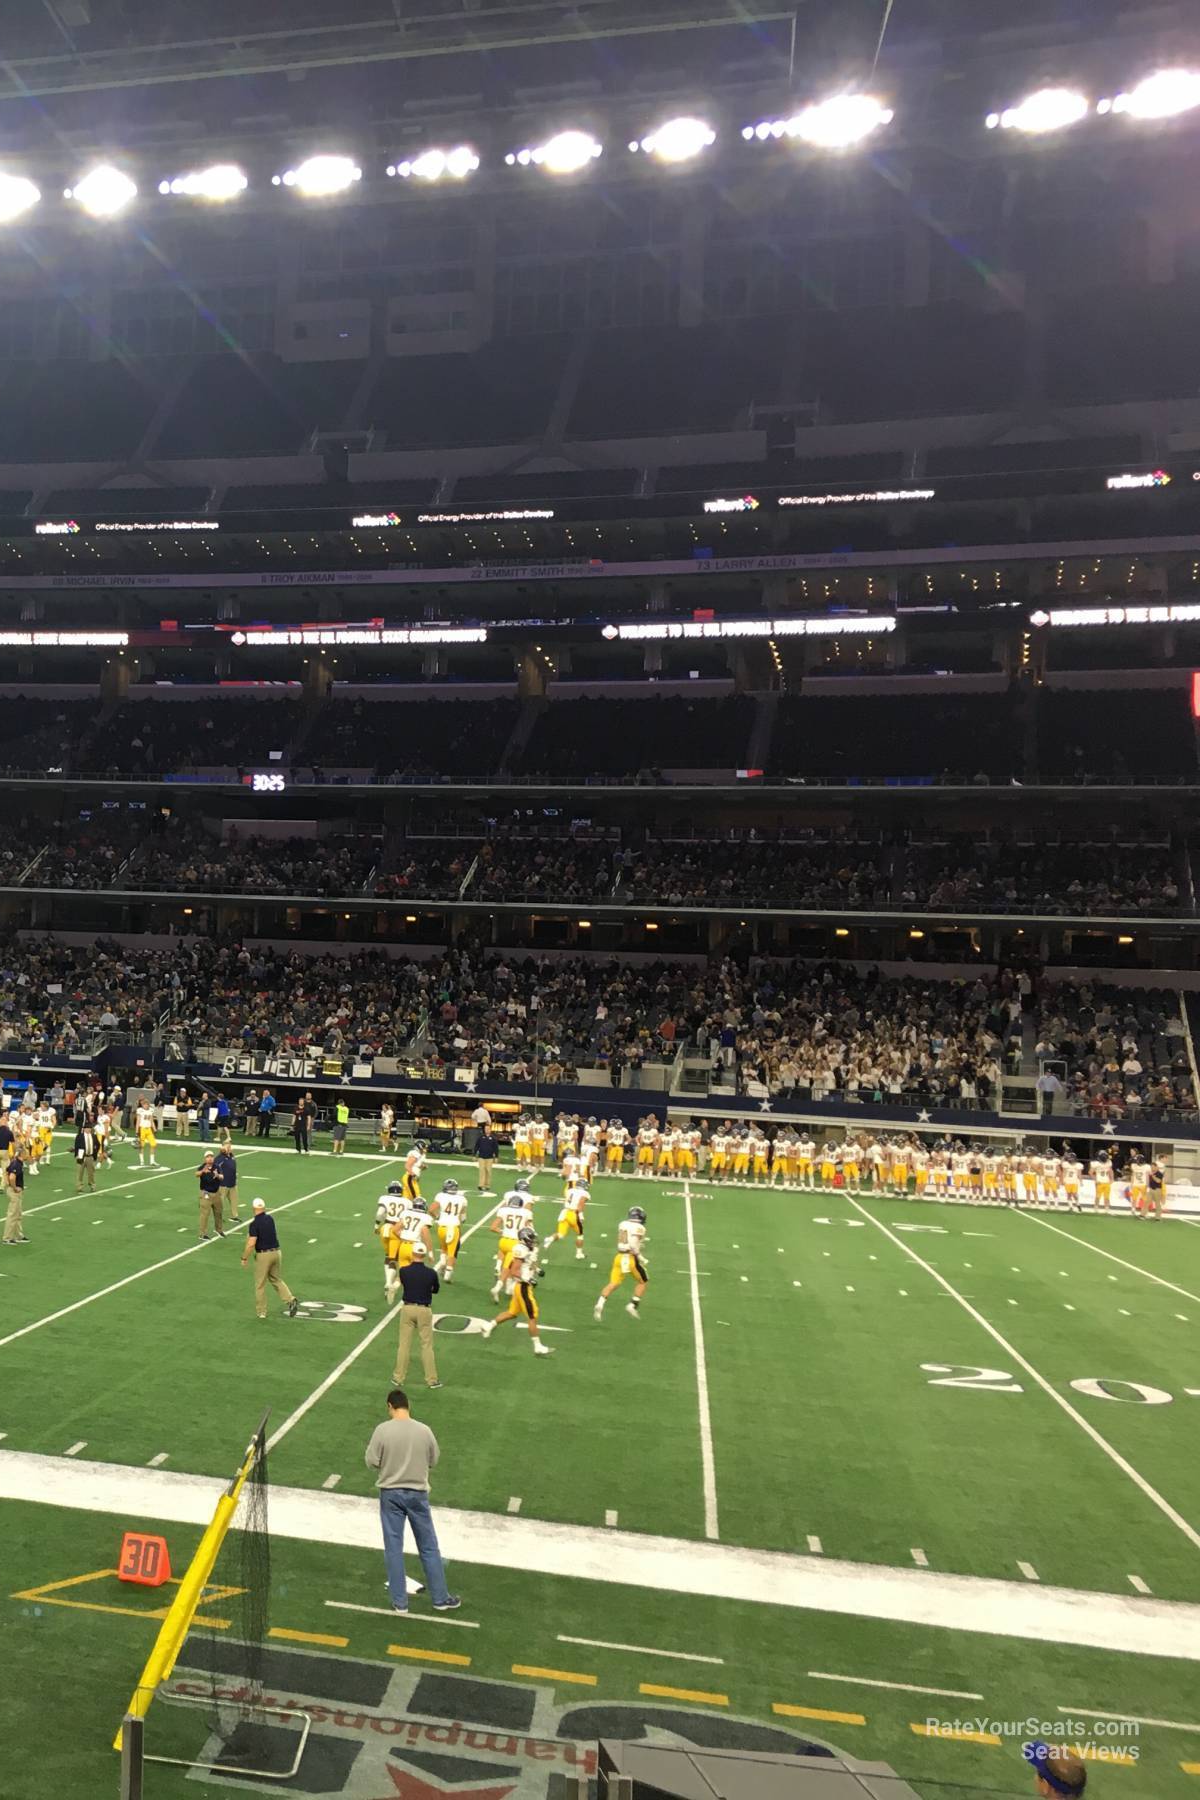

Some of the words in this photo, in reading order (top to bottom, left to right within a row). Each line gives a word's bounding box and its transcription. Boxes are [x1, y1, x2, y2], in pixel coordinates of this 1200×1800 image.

[696, 560, 711, 571] 73
[715, 559, 754, 570] LARRY
[757, 557, 796, 567] ALLEN
[270, 574, 294, 583] TROY
[296, 573, 336, 583] AIKMAN
[485, 567, 528, 578] EMMITT
[530, 567, 564, 577] SMITH
[388, 1201, 405, 1218] 32
[445, 1202, 459, 1217] 41
[403, 1216, 421, 1232] 37
[505, 1214, 523, 1230] 57
[123, 1539, 160, 1578] 30
[174, 1681, 598, 1774] hampionships
